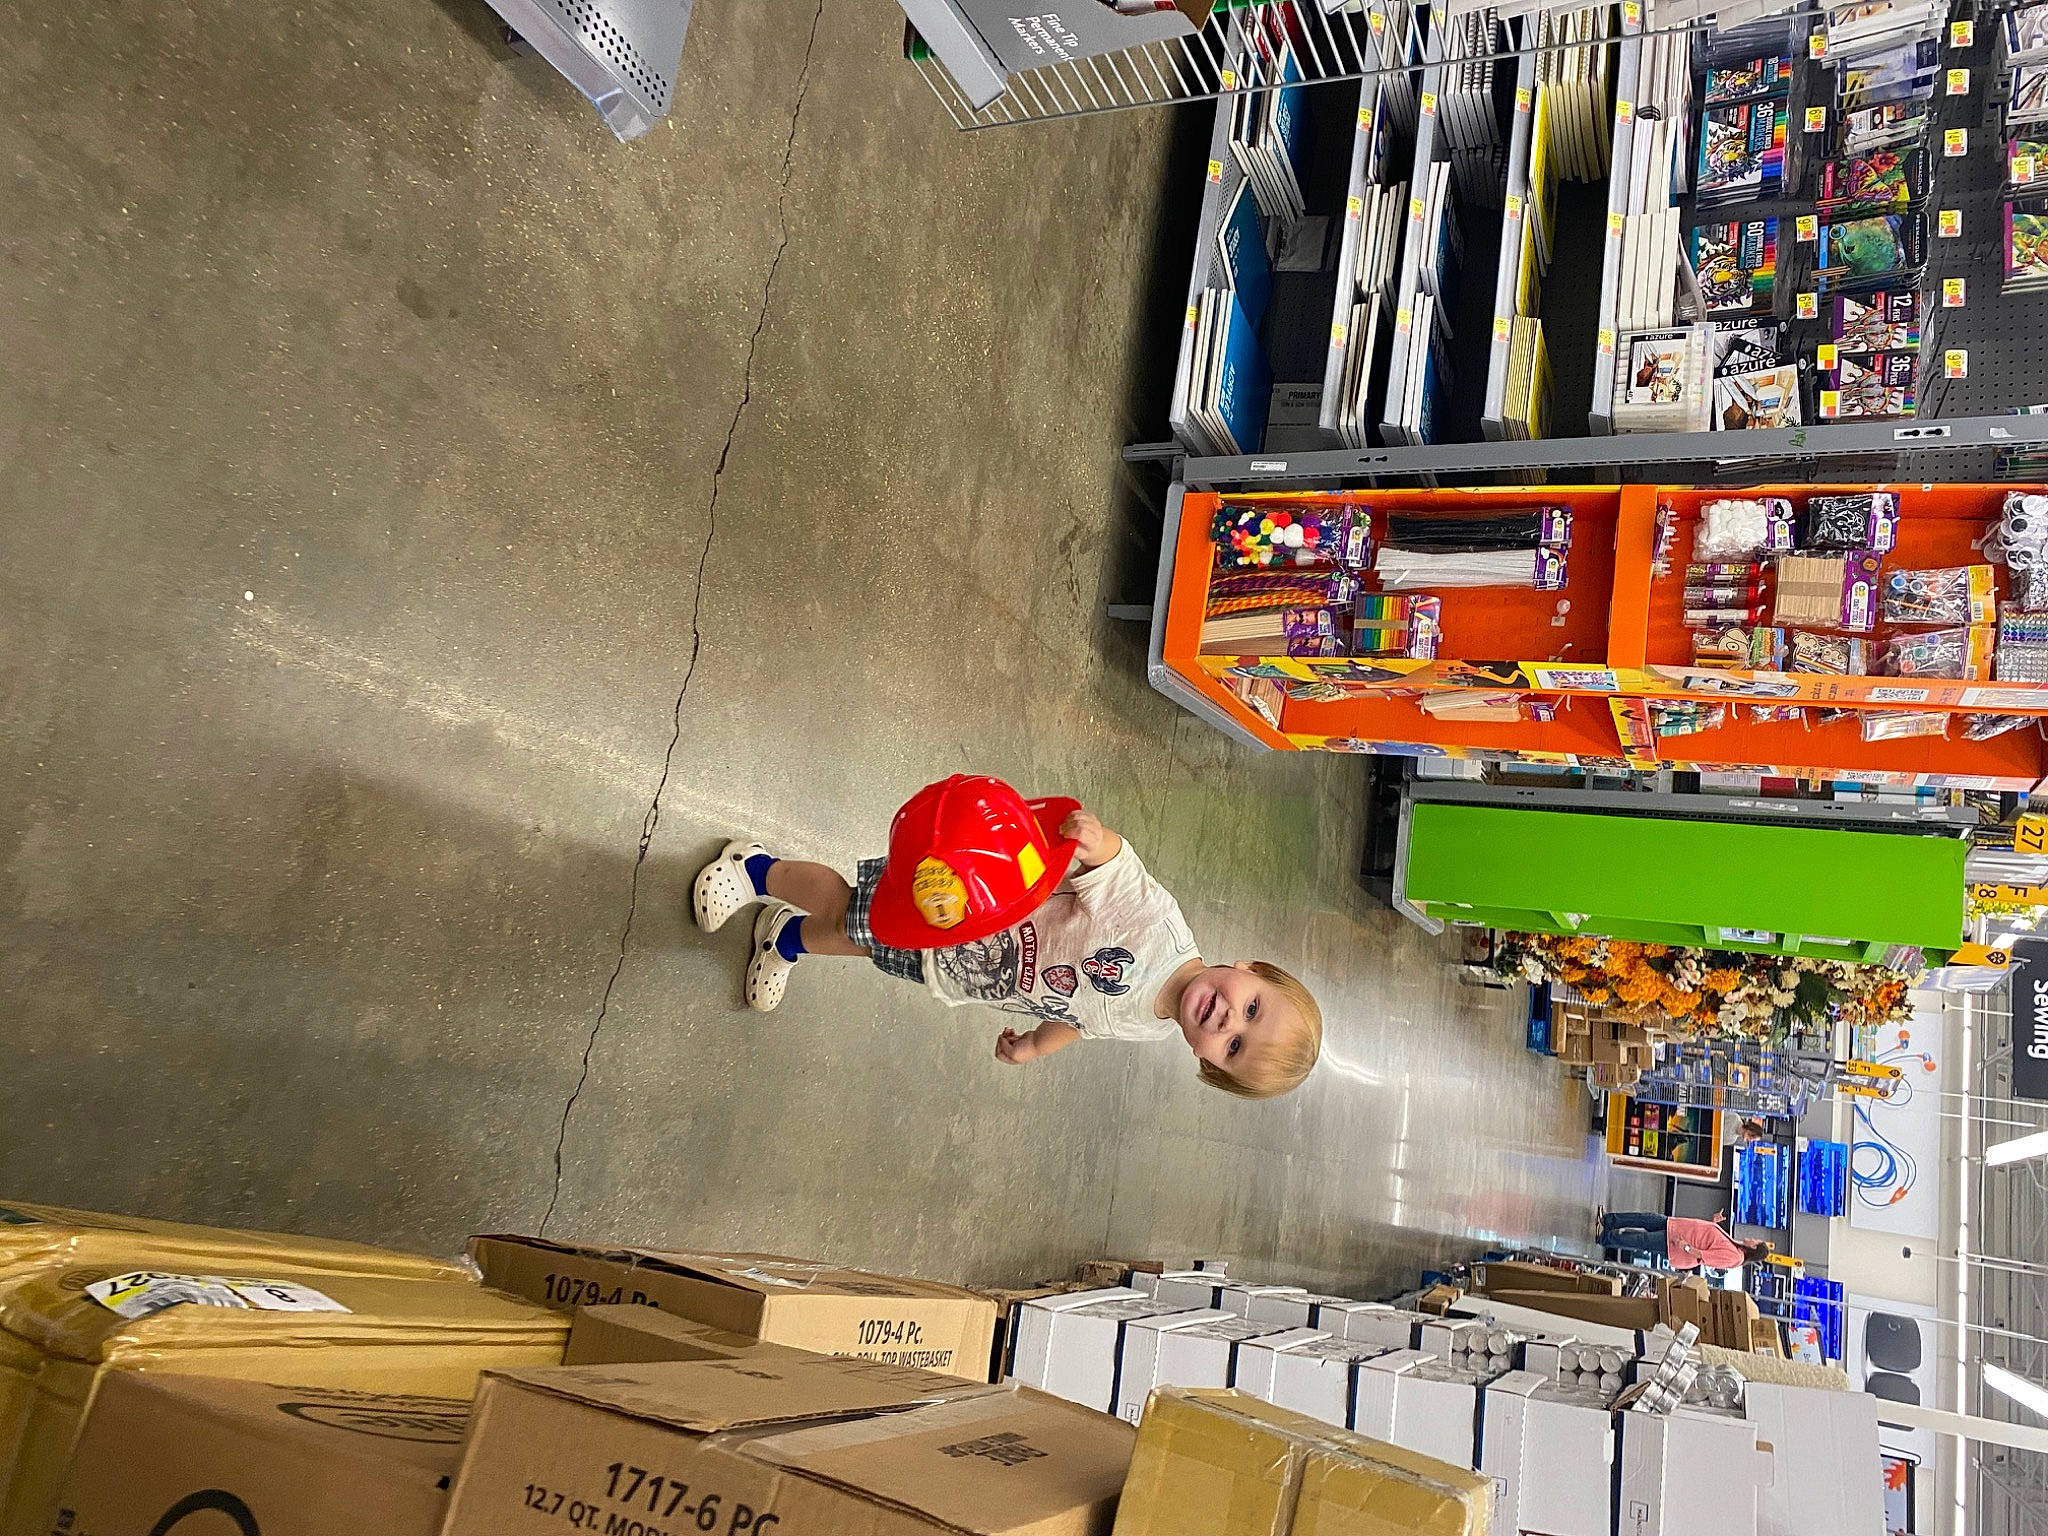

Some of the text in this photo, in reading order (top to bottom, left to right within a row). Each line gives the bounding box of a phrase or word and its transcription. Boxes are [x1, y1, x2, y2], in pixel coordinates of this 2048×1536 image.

[1008, 18, 1046, 54] Markers
[1025, 16, 1074, 61] Permanent
[1042, 14, 1078, 47] Fine Tip
[1757, 102, 1774, 117] 36
[1754, 118, 1766, 151] MARKERS
[1747, 222, 1764, 236] 60
[1745, 236, 1756, 269] MARKERS
[1893, 292, 1912, 307] 12
[1892, 308, 1900, 322] PENS
[1650, 332, 1674, 340] azure
[1728, 358, 1776, 374] azure
[1892, 356, 1910, 371] 36
[1224, 362, 1236, 418] ACRYLIC
[1889, 372, 1898, 385] PENS
[2021, 825, 2044, 850] 27
[1021, 926, 1035, 991] MOTOR CLUB
[2027, 980, 2048, 1060] Sewing
[544, 1273, 623, 1306] 1079-4
[858, 1320, 923, 1344] 1079-4 Pc.
[899, 1350, 952, 1368] WASTEBASKET
[523, 1484, 565, 1515] 12.7
[568, 1501, 600, 1530] QT.
[606, 1462, 722, 1532] 1717-6
